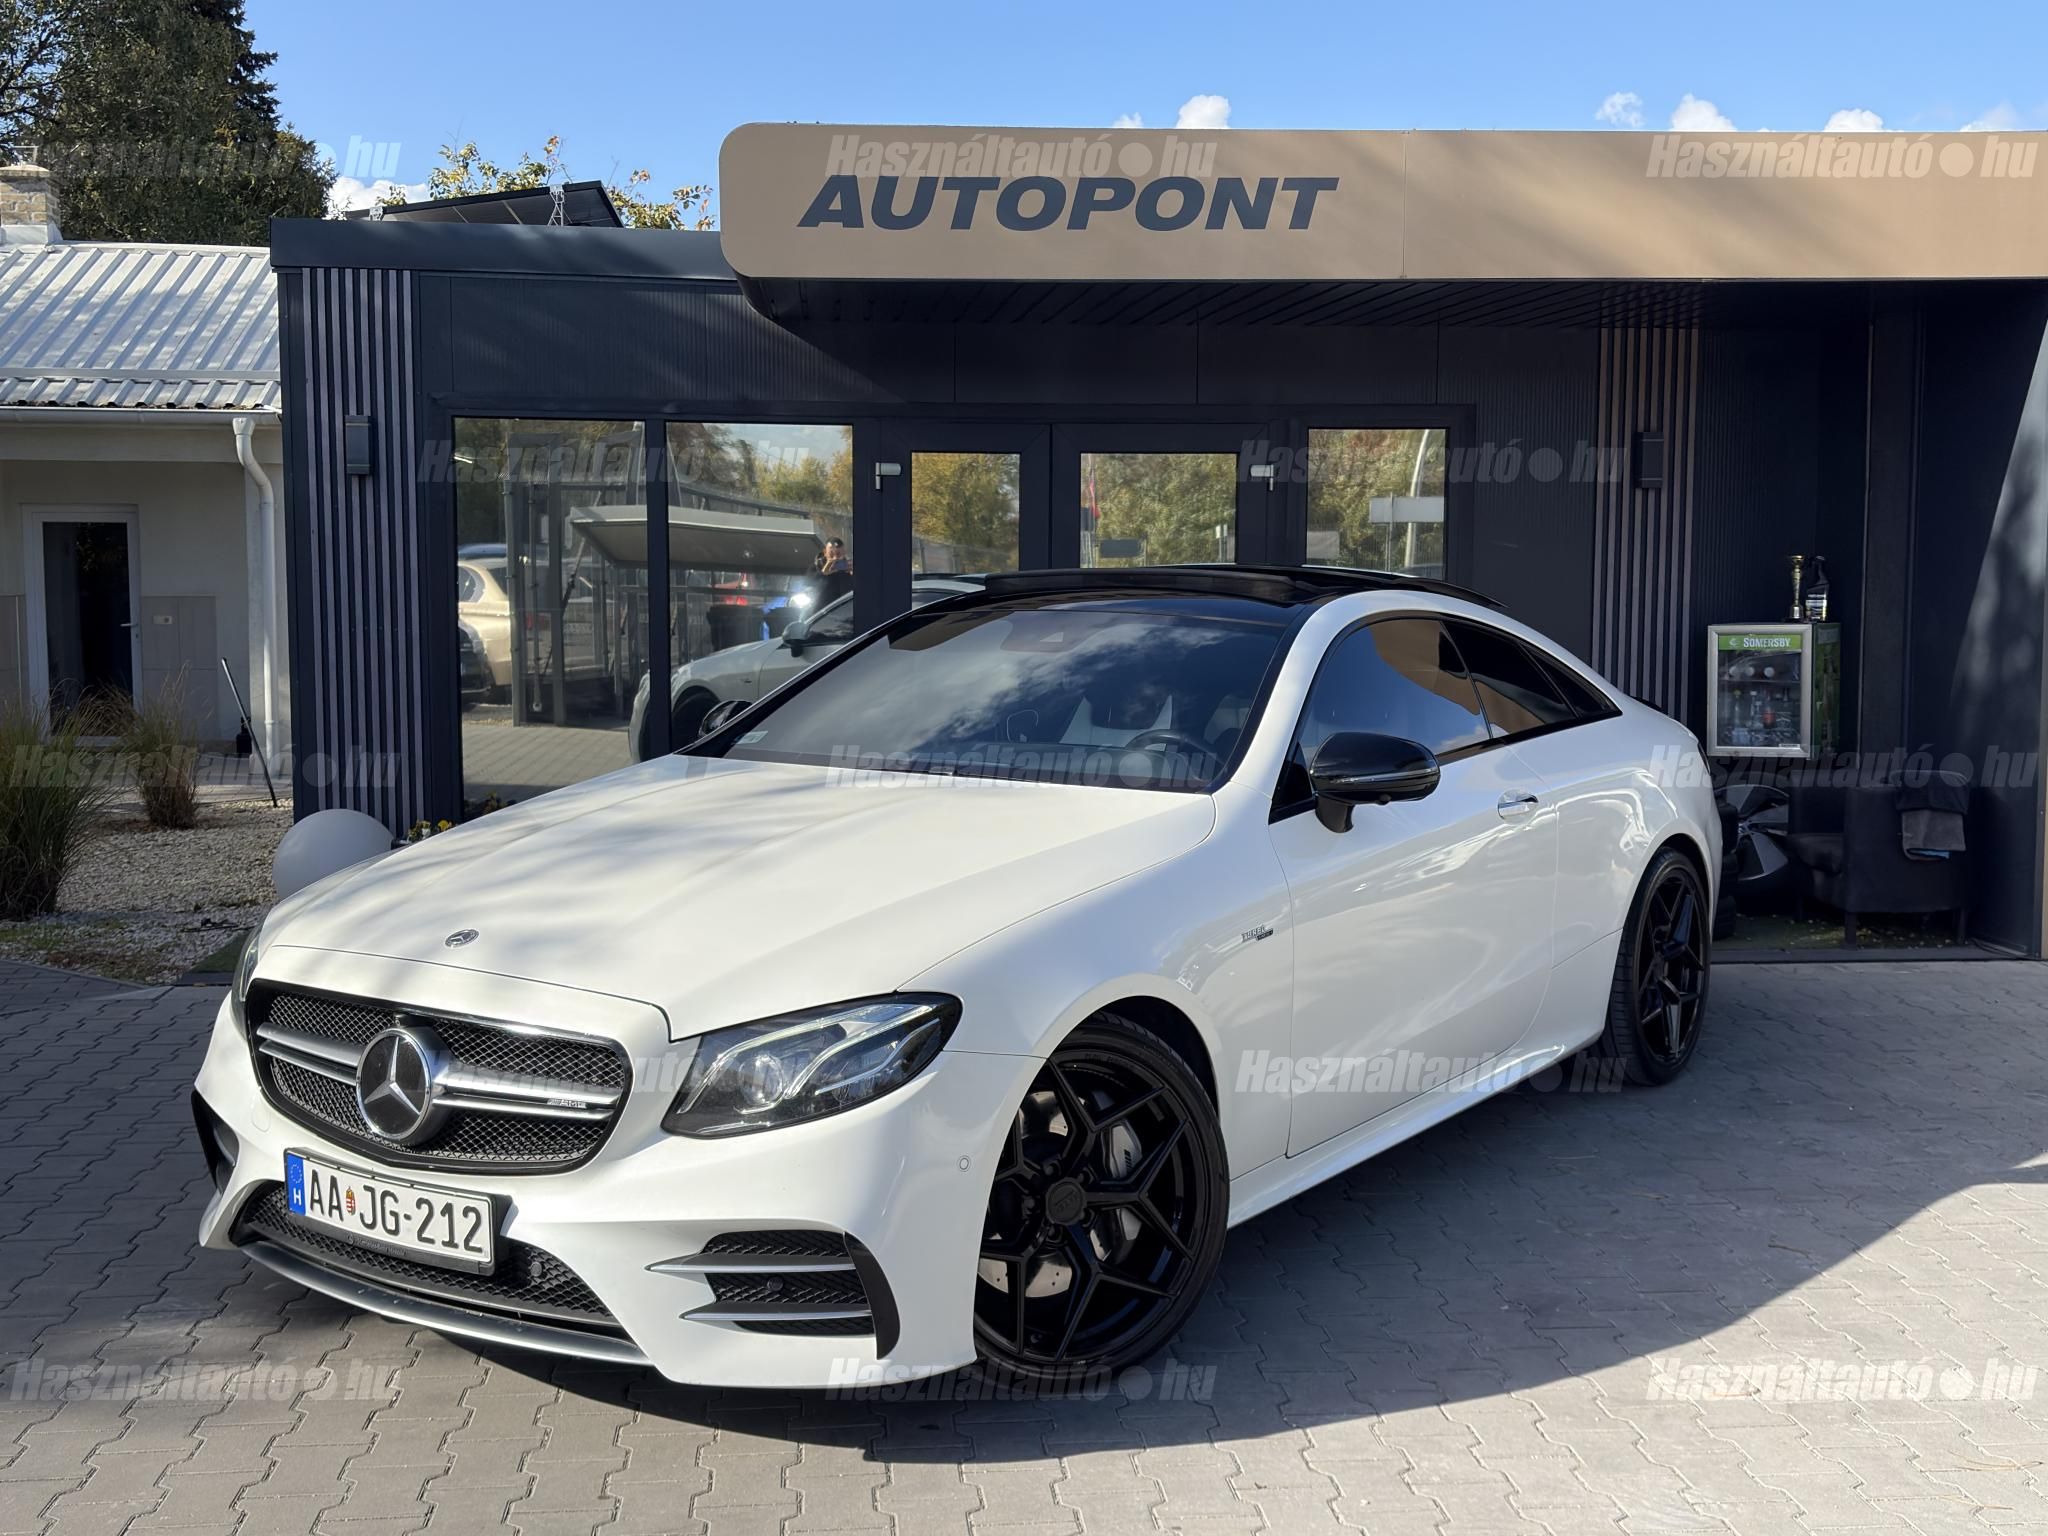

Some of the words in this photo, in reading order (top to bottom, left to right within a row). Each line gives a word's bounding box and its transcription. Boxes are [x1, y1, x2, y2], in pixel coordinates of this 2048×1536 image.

[797, 174, 1339, 231] AUTOPONT
[1743, 637, 1792, 648] SOMERSBY
[293, 1187, 302, 1206] H
